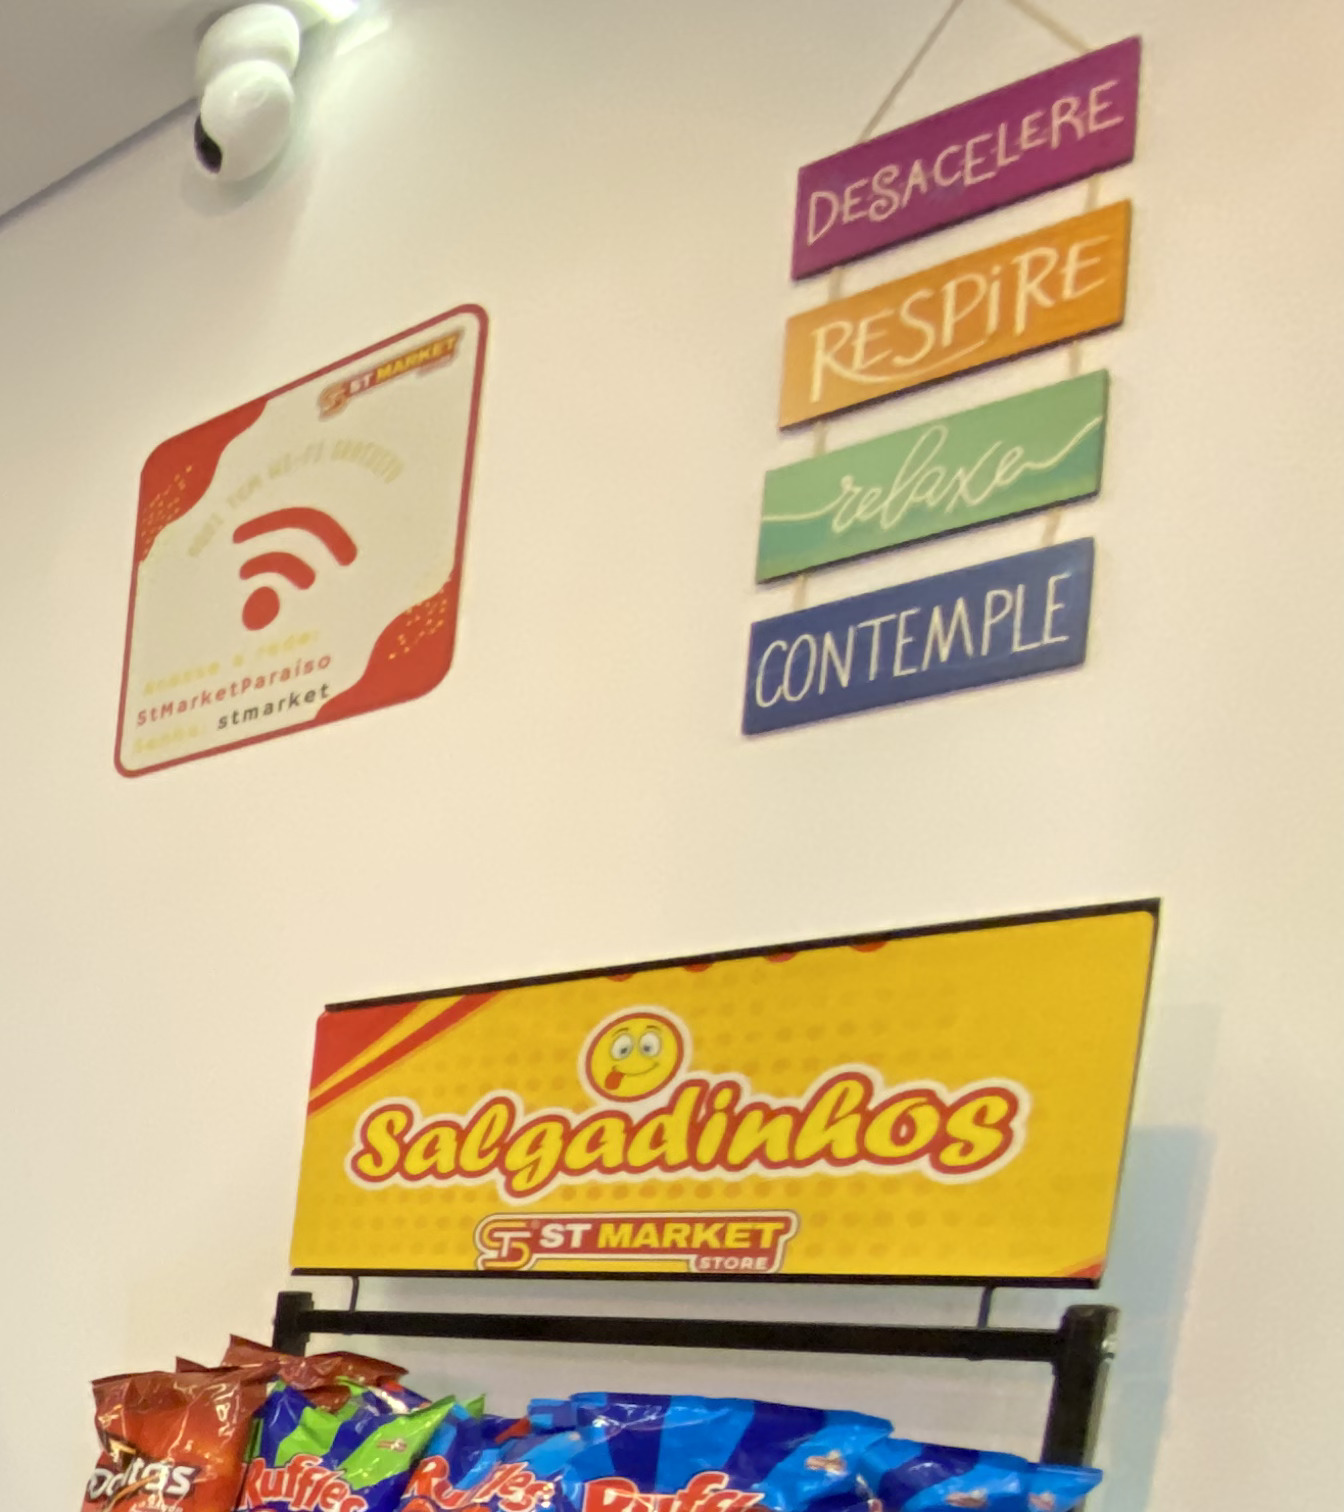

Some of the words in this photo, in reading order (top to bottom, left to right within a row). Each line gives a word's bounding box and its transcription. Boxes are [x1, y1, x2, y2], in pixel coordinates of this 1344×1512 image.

[806, 79, 1125, 248] DESACELERE
[376, 334, 457, 381] MARKET
[822, 423, 1057, 534] relaxe
[755, 573, 1070, 709] CONTEMPLE
[217, 681, 331, 731] stmarket
[352, 1076, 1018, 1197] Salgadinhos
[539, 1222, 591, 1252] ST
[598, 1218, 785, 1252] MARKET
[700, 1253, 769, 1273] STORE
